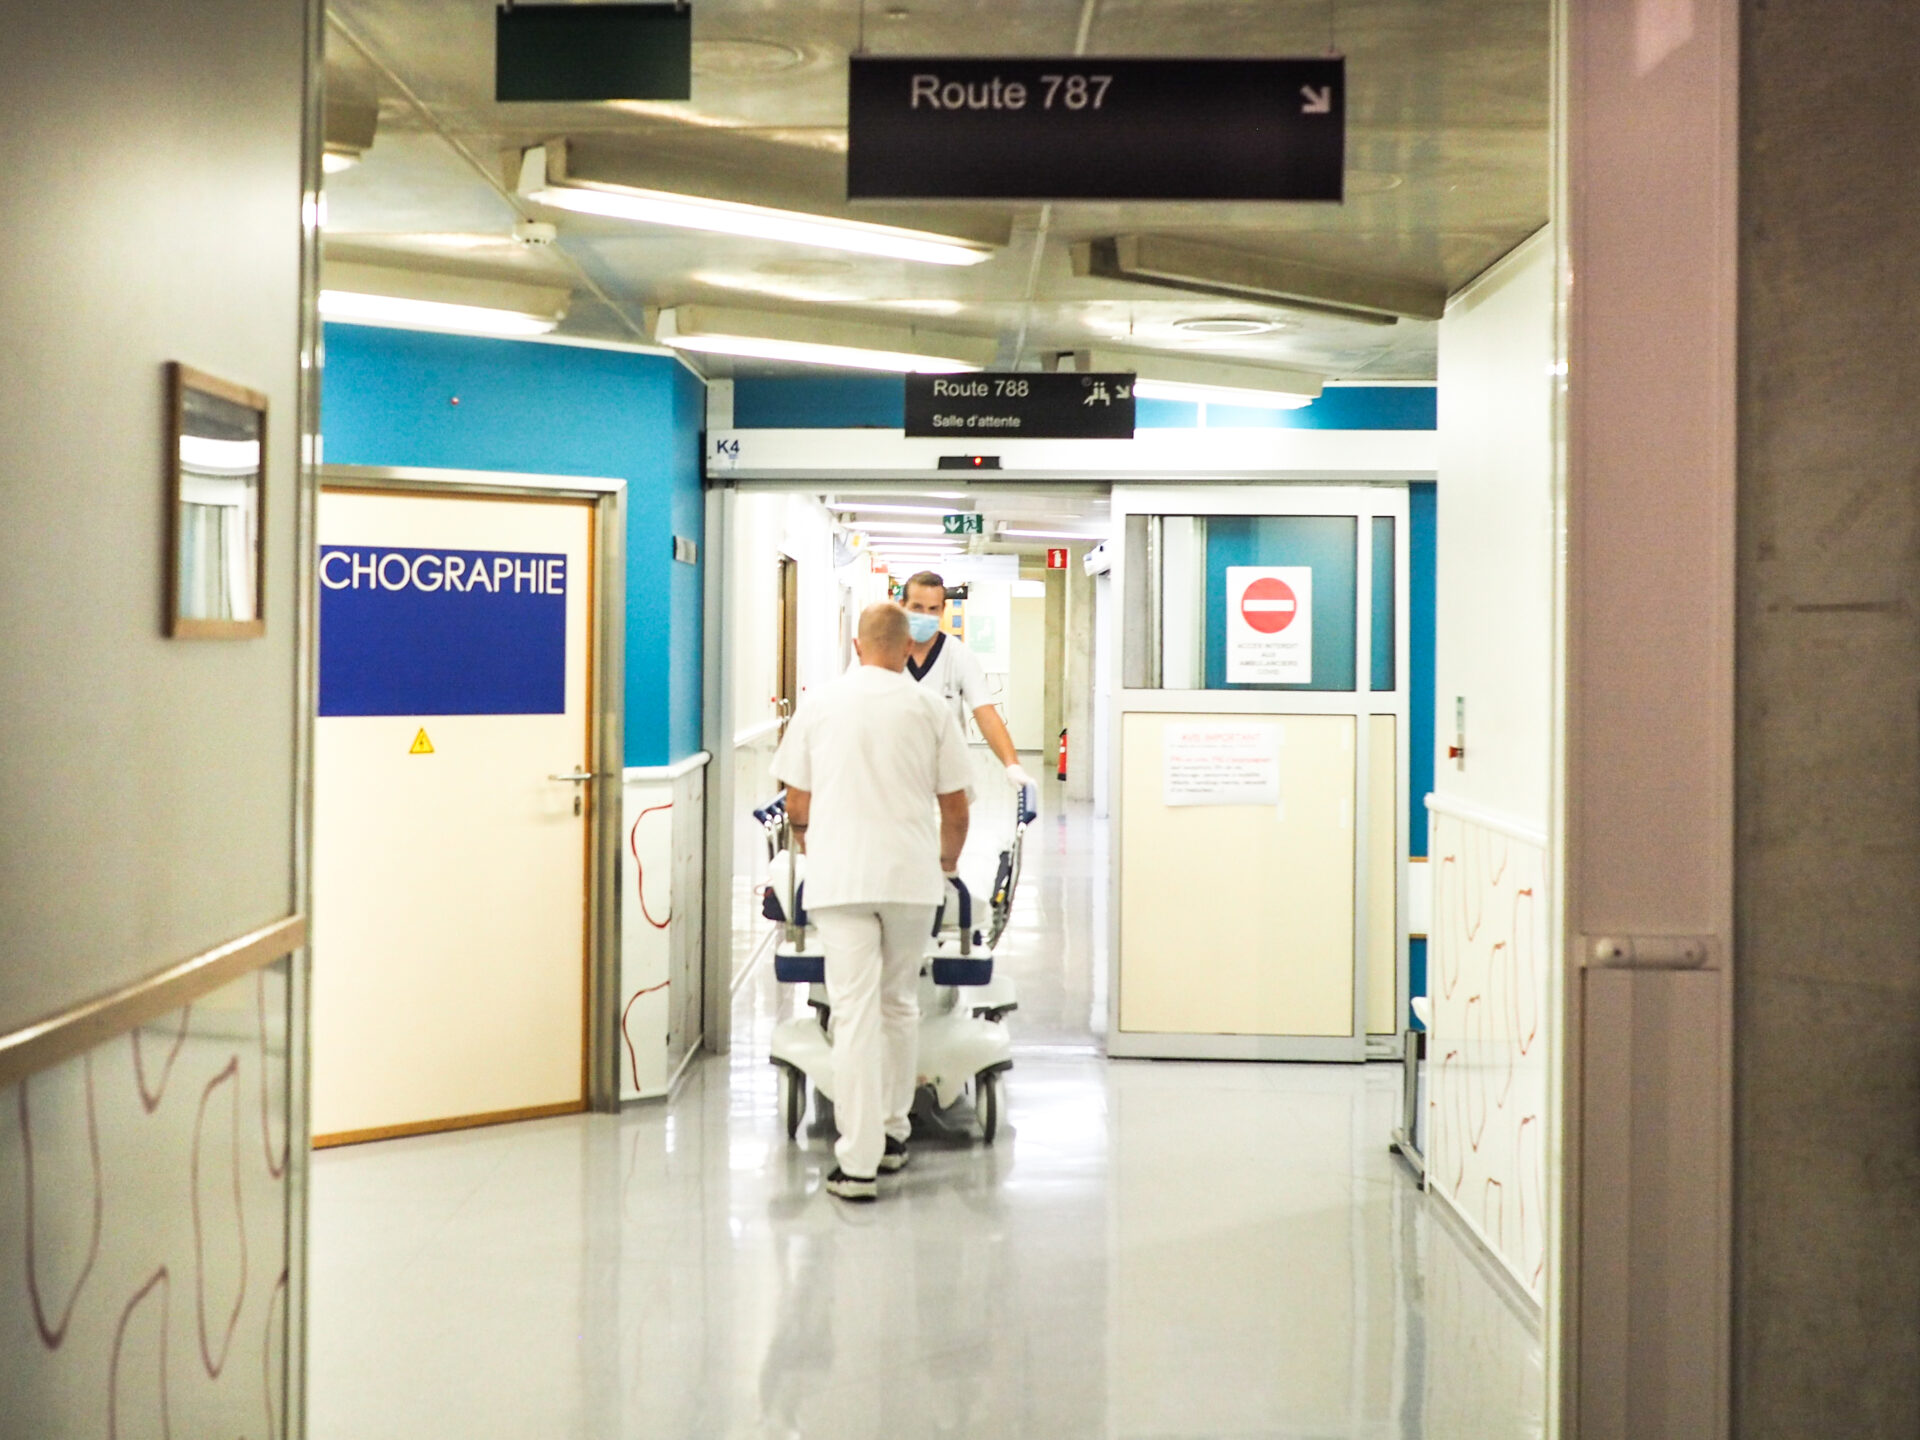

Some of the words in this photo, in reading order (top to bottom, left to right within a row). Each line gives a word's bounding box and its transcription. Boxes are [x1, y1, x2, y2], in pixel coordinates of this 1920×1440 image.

[911, 74, 1028, 109] Route
[1040, 75, 1113, 110] 787
[933, 379, 989, 397] Route
[994, 380, 1029, 398] 788
[932, 414, 964, 428] Salle
[966, 414, 1022, 428] d'attente
[716, 439, 740, 454] K4
